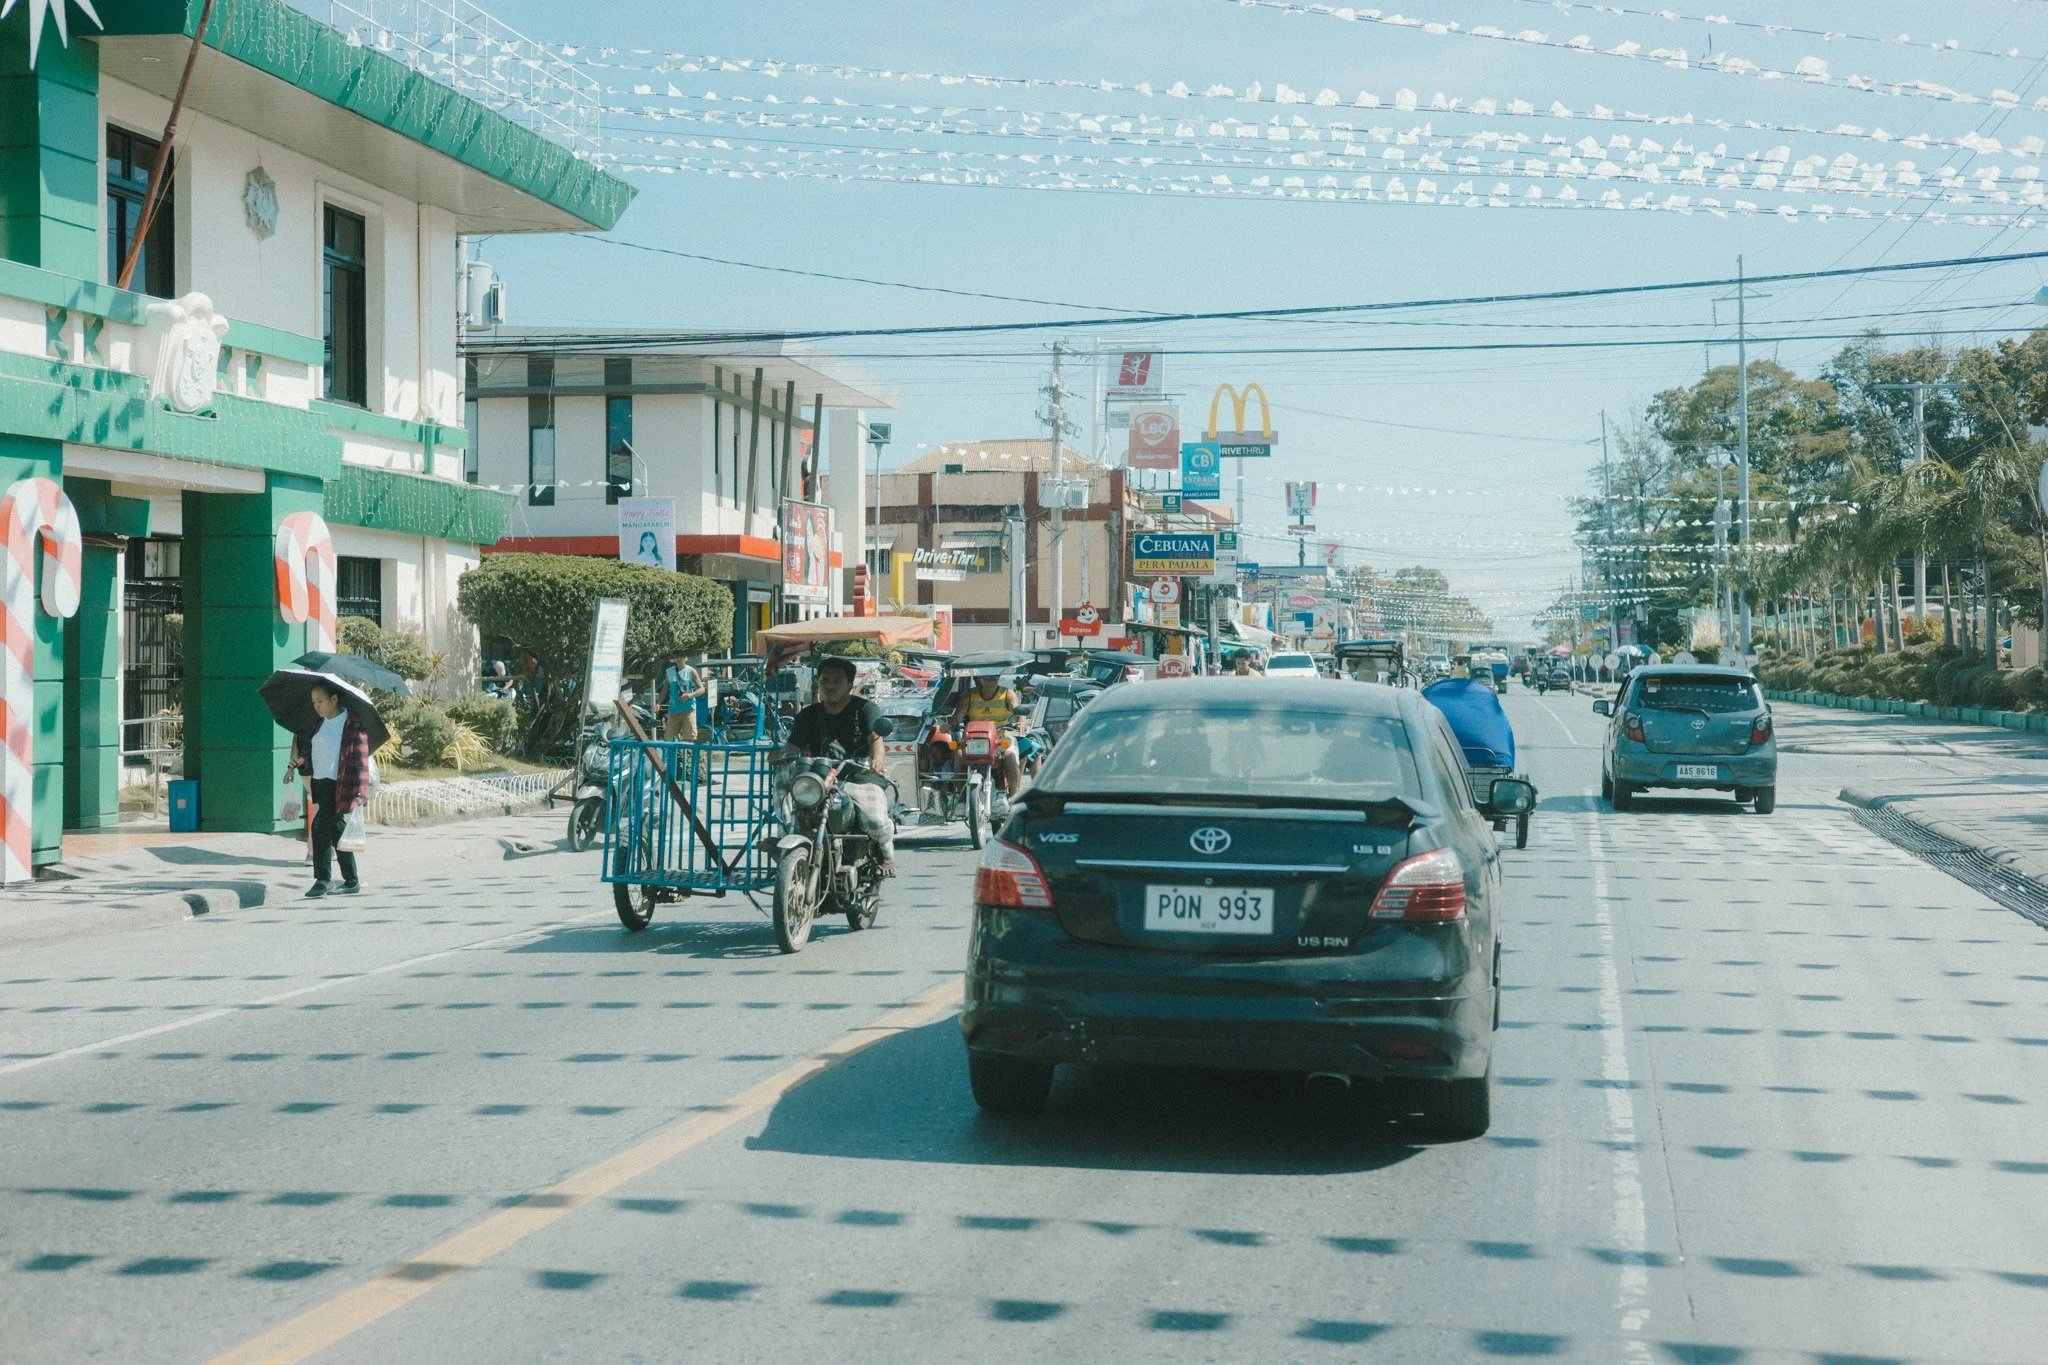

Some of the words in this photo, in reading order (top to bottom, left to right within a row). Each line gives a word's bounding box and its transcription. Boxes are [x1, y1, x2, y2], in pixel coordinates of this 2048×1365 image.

[1220, 446, 1264, 455] RIVETHRU
[1191, 454, 1210, 468] CB
[1292, 507, 1311, 515] KFC
[1139, 537, 1210, 554] CEBUANA
[1140, 560, 1166, 569] PERA
[1168, 560, 1209, 569] PADALA
[1165, 665, 1182, 674] LBC
[1679, 767, 1693, 775] AAS
[1039, 833, 1080, 843] VIOS
[1218, 896, 1262, 921] 993
